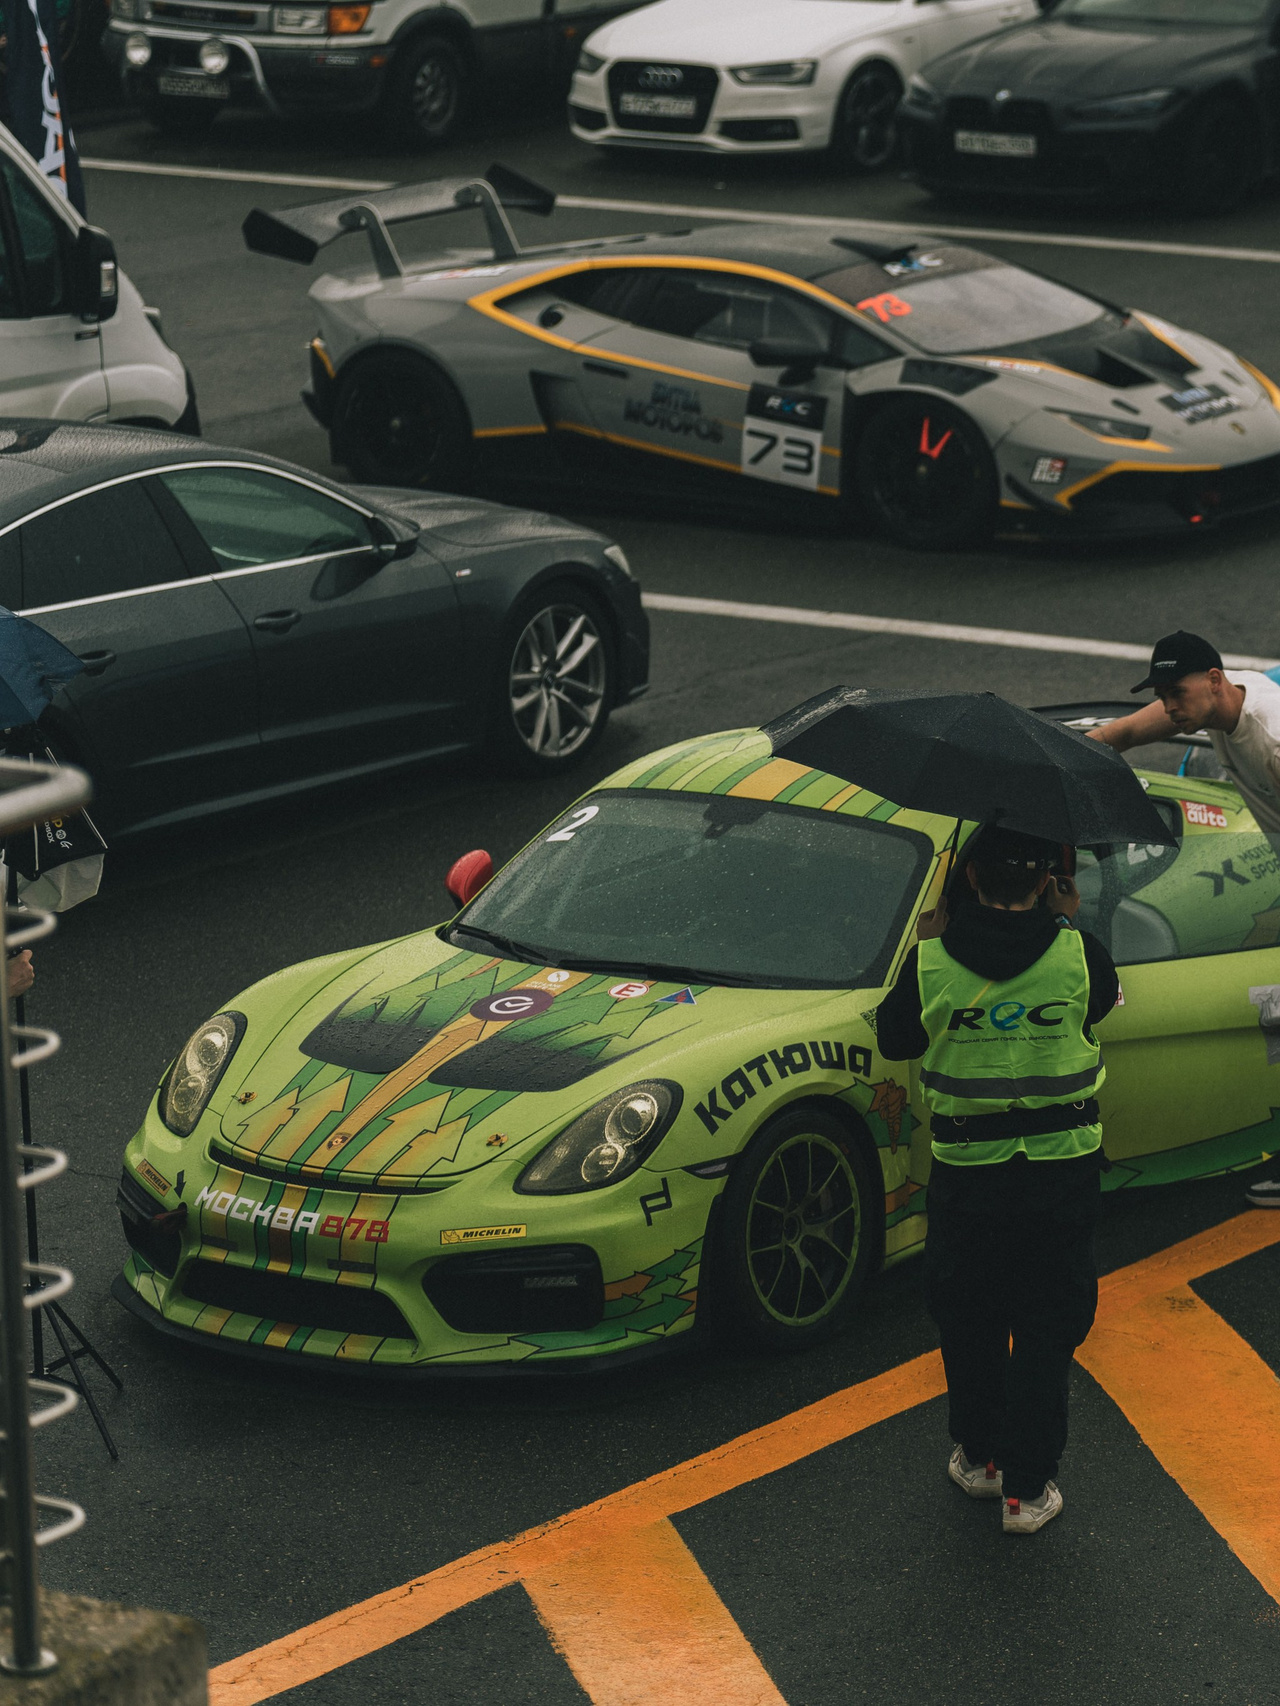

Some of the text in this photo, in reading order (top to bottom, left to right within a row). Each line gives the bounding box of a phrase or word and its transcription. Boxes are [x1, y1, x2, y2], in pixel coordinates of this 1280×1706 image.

[747, 428, 816, 475] 73
[545, 805, 600, 842] 2
[1187, 808, 1228, 828] auto
[1237, 843, 1273, 863] MOTO
[616, 983, 641, 997] E
[693, 1041, 872, 1136] КАТЮША
[142, 1164, 169, 1192] MICHELIN
[462, 1227, 521, 1239] MICHELIN
